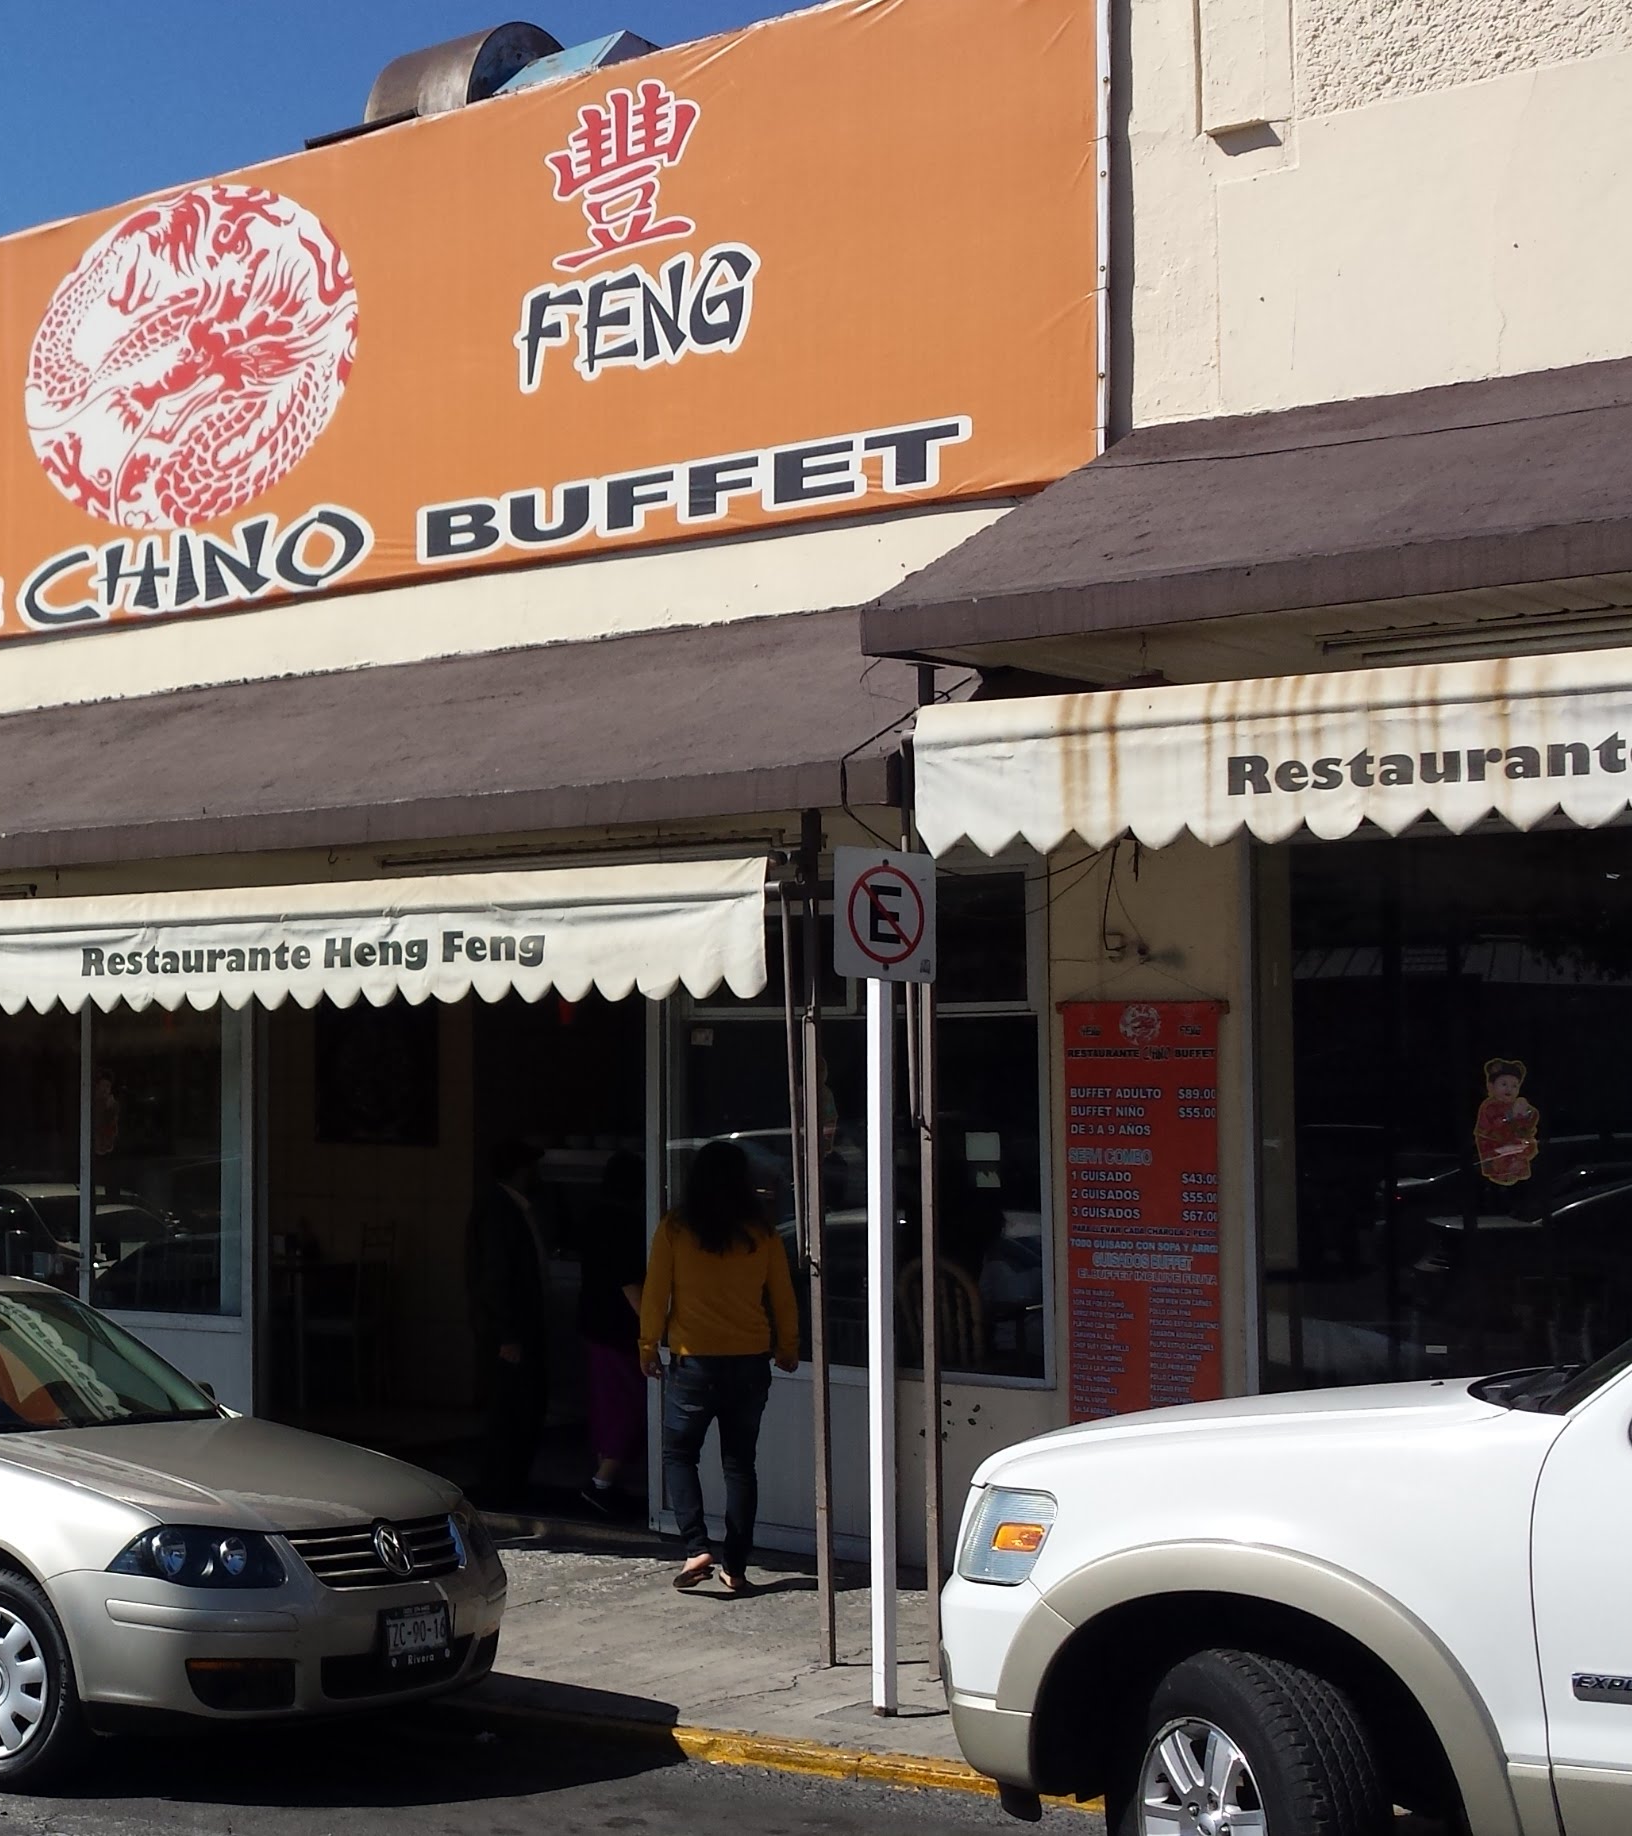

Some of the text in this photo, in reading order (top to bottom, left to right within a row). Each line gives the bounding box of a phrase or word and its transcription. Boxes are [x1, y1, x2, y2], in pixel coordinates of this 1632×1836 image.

[517, 242, 760, 394] FENG
[19, 503, 374, 631] CHINO
[417, 415, 972, 566] BUFFET
[1226, 730, 1632, 796] Restaurant
[869, 884, 903, 945] E
[81, 930, 546, 977] Restaurante Heng Feng
[1067, 1048, 1140, 1059] RESTAURANTE
[1173, 1048, 1216, 1059] BUFFET
[1070, 1087, 1216, 1100] BUFFET ADULTO $89.00
[1070, 1104, 1216, 1119] BUFFET NIÑO $55.00
[1070, 1121, 1152, 1136] DE 3 A 9 AÑOS
[1104, 1147, 1153, 1166] COMBO
[1071, 1171, 1077, 1181] 1
[1080, 1170, 1132, 1182] GUISADO
[1071, 1188, 1078, 1199] 2
[1081, 1189, 1140, 1201] GUISADOS
[1071, 1207, 1078, 1217] 3
[1081, 1207, 1141, 1219] GUISADOS
[1147, 1227, 1187, 1237] CHAROLA
[1093, 1239, 1134, 1250] GUISADO
[1135, 1240, 1156, 1251] CON
[1157, 1242, 1181, 1252] SOPA
[1182, 1243, 1189, 1253] Y
[1091, 1252, 1194, 1271] GUISADOS BUFFET
[1092, 1269, 1133, 1281] BUFFET
[1135, 1271, 1181, 1284] INCLUYE
[1183, 1273, 1218, 1286] FRUTA
[408, 1653, 435, 1666] Rivera
